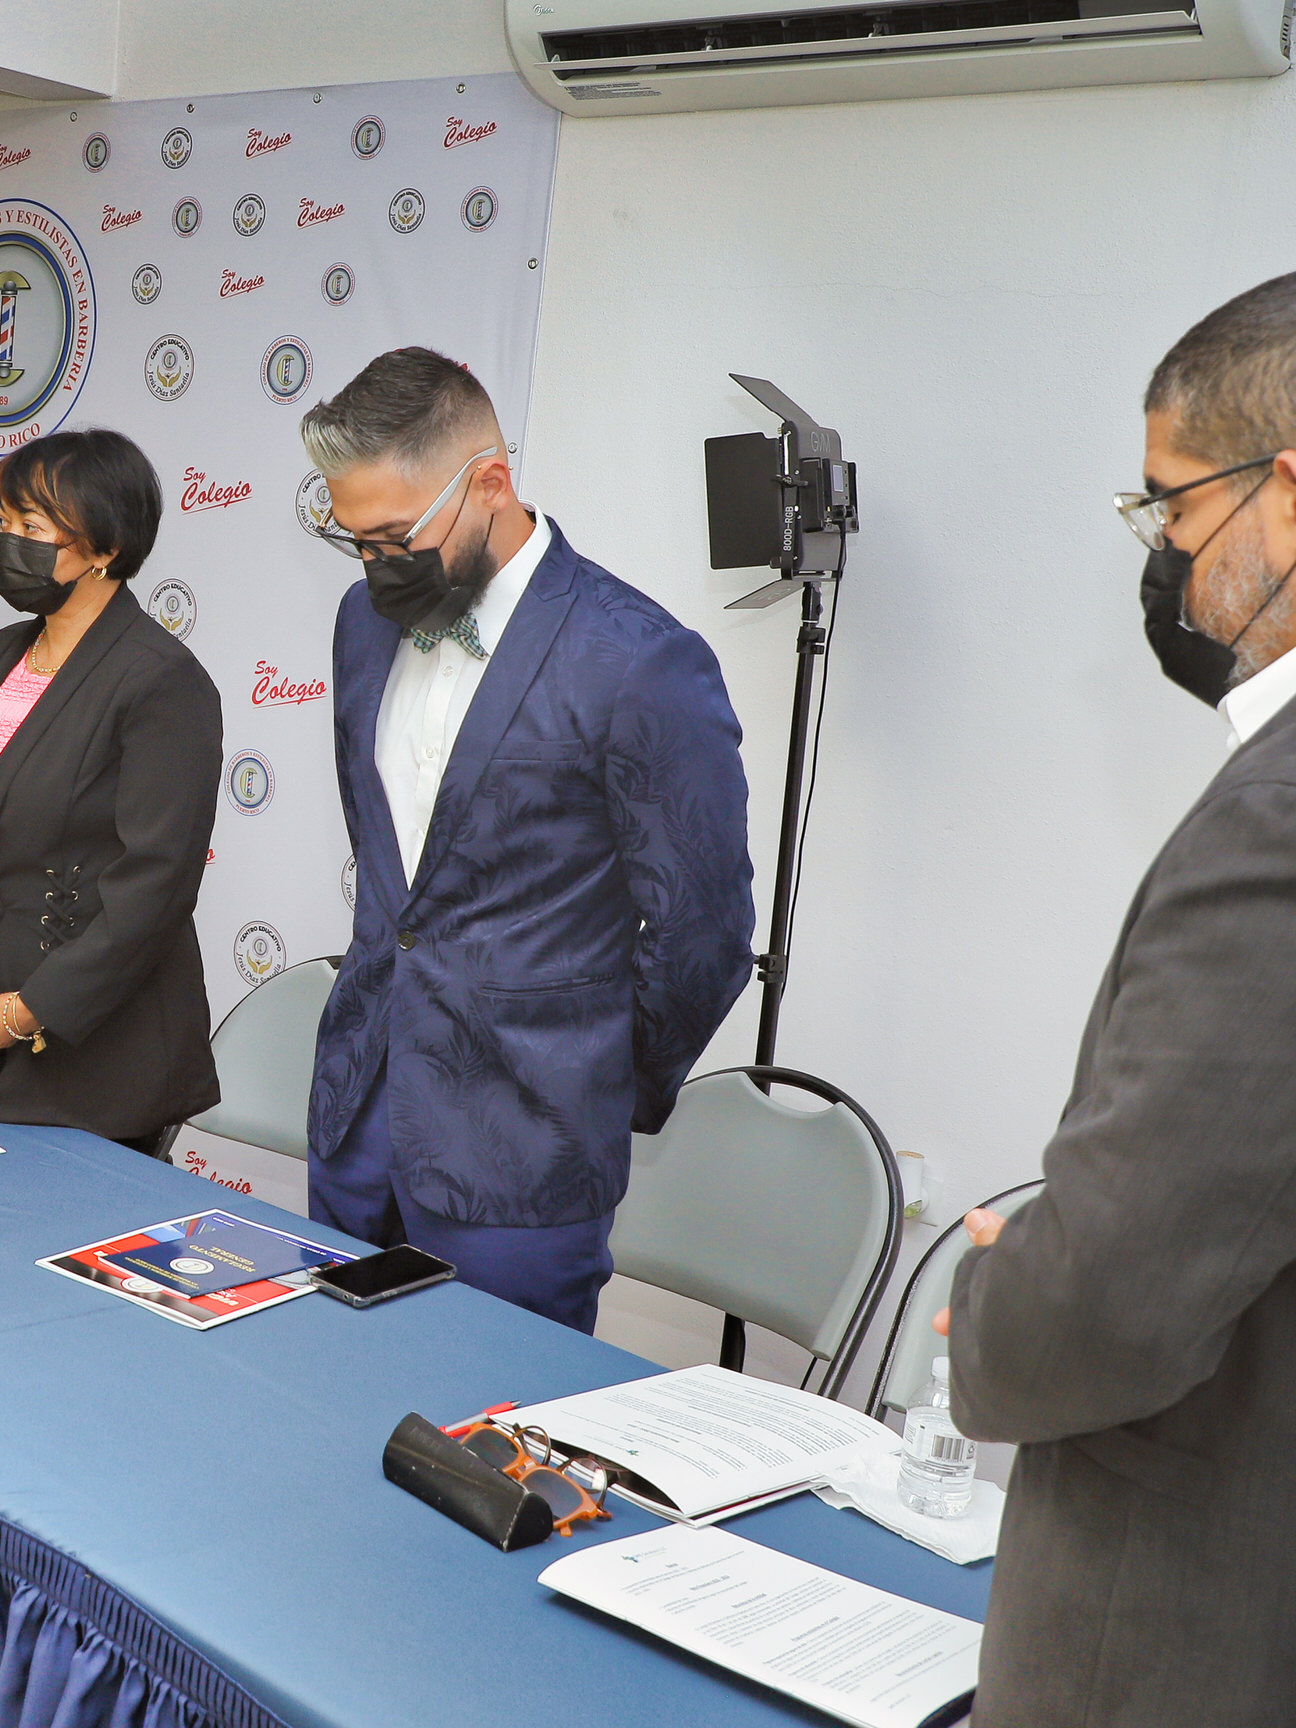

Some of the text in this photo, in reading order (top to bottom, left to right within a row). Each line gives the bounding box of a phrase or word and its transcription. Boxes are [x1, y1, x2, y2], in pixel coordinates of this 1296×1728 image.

[248, 128, 262, 139] Soy
[446, 117, 463, 128] Soy
[246, 133, 292, 157] Colegio
[444, 121, 497, 148] Colegio
[103, 204, 115, 214] Soy
[299, 197, 314, 208] Soy
[5, 210, 14, 222] Y
[101, 209, 142, 231] Colegio
[298, 202, 345, 227] Colegio
[16, 209, 78, 270] ESTILISTAS
[72, 268, 86, 294] EN
[220, 274, 265, 298] Colegio
[221, 269, 236, 280] Soy
[63, 298, 88, 392] BARBERIA
[150, 339, 189, 360] CENTRO EDUCATIVO
[9, 422, 41, 448] RICO
[183, 467, 206, 482] Soy
[302, 473, 321, 493] CENTRO
[181, 480, 252, 510] Colegio
[783, 506, 794, 551] 800D-RGB
[154, 583, 192, 606] CENTRO EDUCATIVO
[255, 660, 278, 676] Soy
[252, 676, 326, 705] Colegio
[240, 926, 282, 952] CENTRO EDUCATIVO
[185, 1151, 207, 1169] Soy
